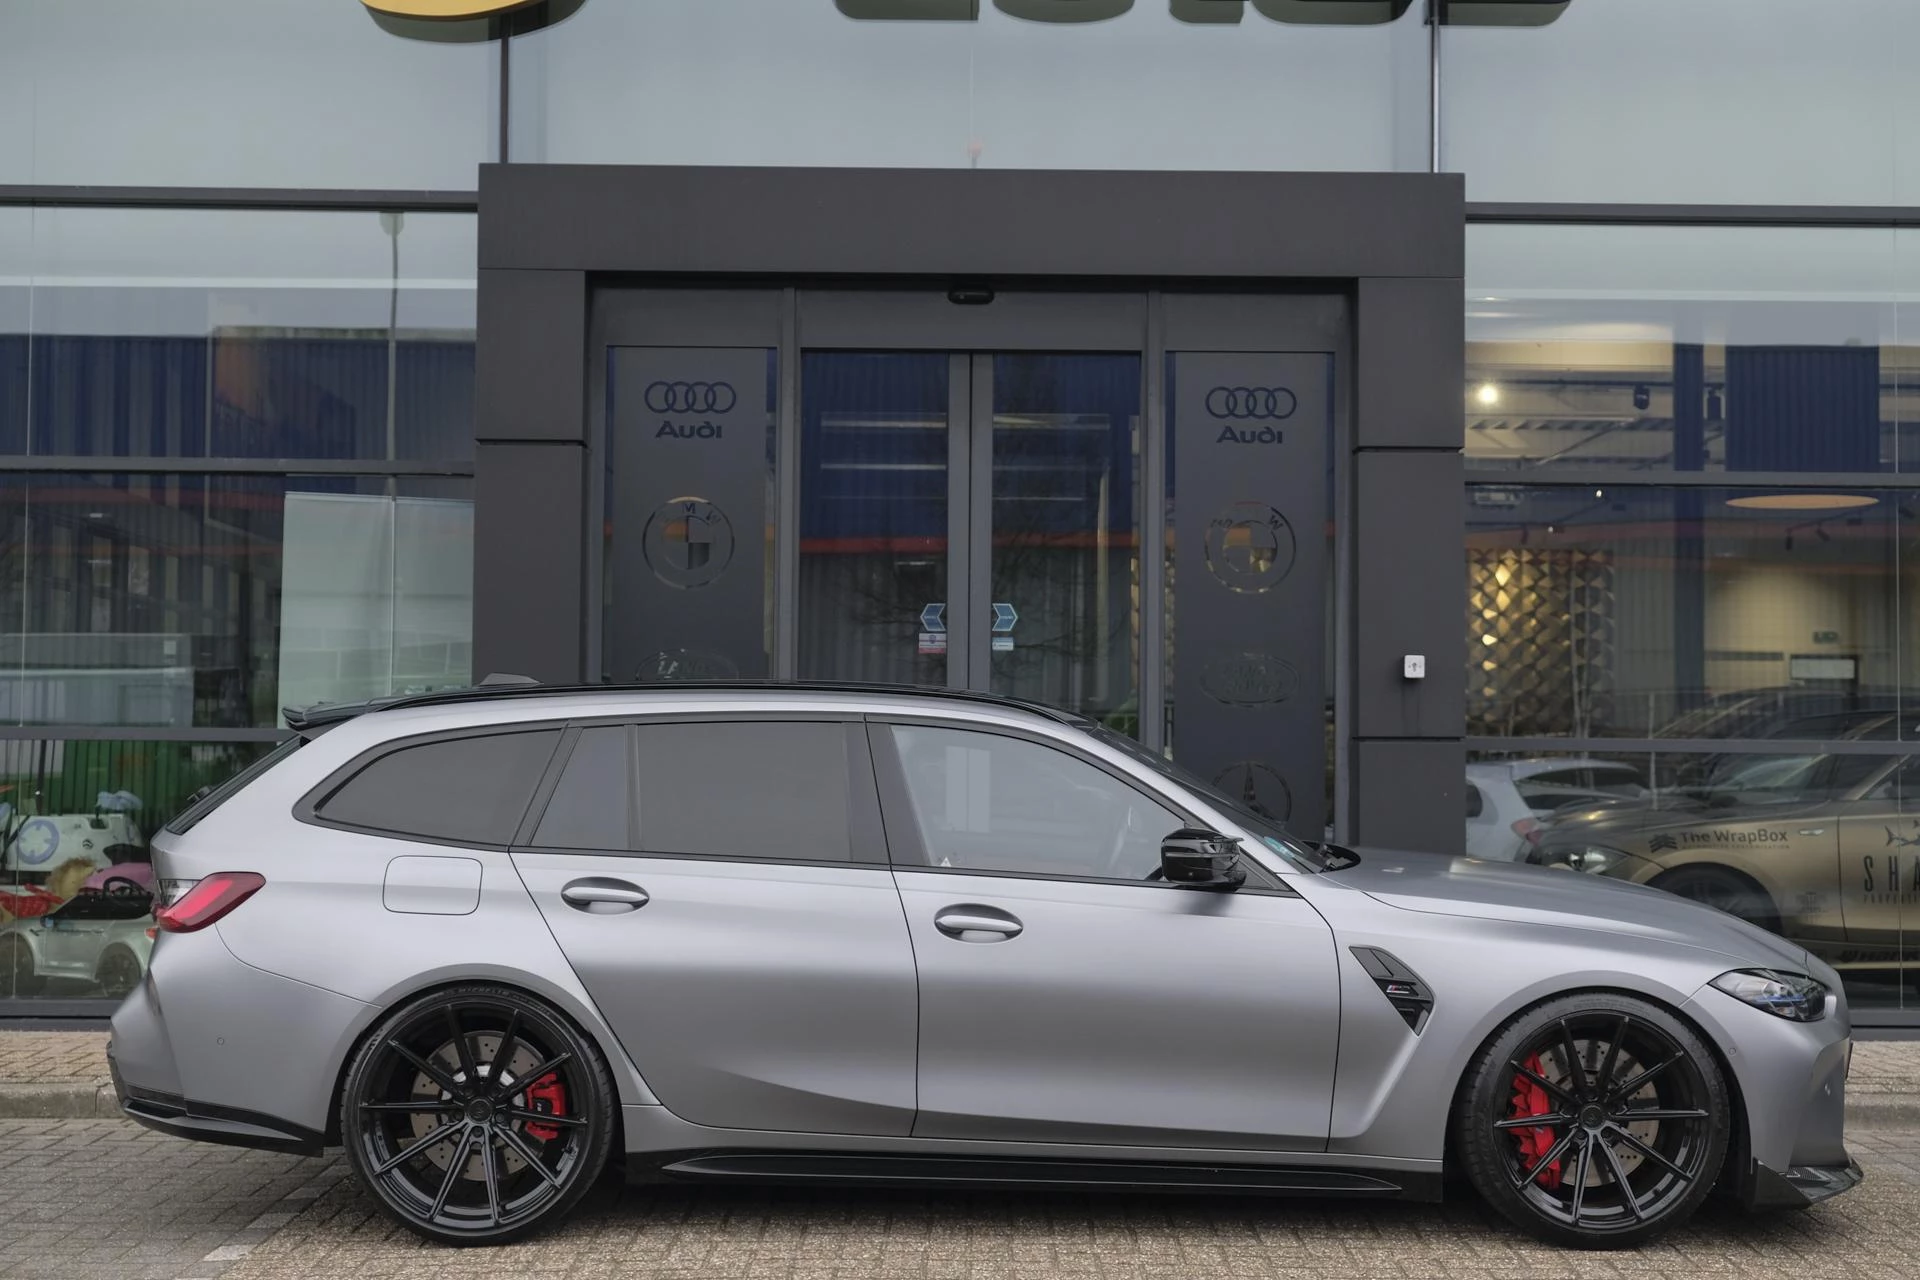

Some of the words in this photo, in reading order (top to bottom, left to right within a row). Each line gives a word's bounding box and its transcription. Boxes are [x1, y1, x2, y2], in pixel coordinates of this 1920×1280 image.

[655, 420, 723, 439] Audi
[1216, 426, 1283, 445] Audi
[1680, 832, 1710, 844] The
[1713, 829, 1789, 845] WrapBox
